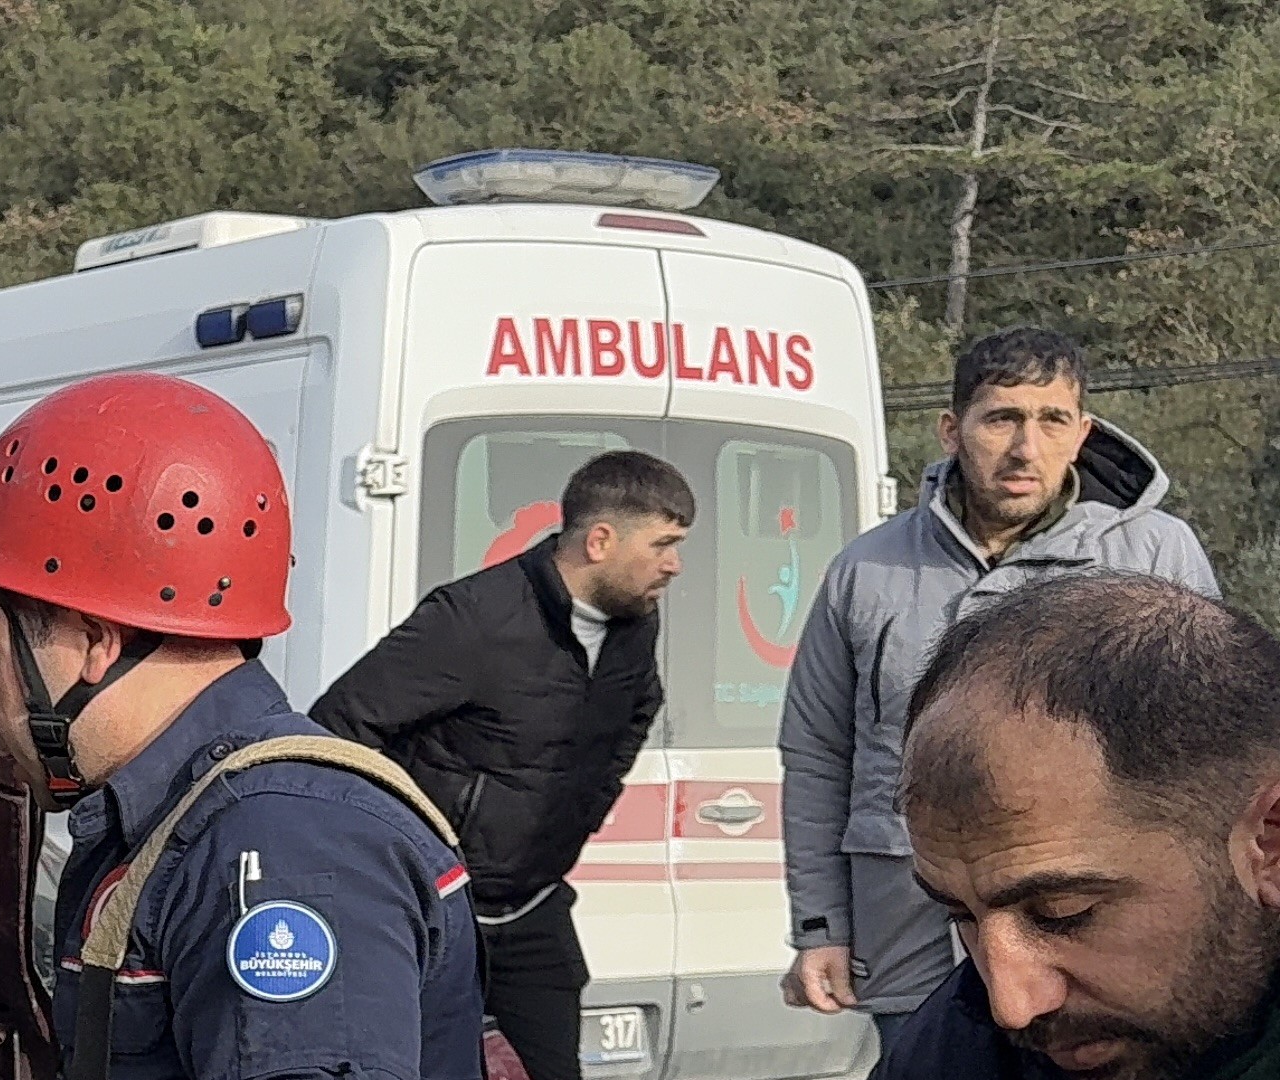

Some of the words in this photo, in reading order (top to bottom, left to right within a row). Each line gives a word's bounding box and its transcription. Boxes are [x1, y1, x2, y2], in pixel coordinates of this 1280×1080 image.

[485, 316, 814, 391] AMBULANS
[240, 957, 323, 973] BÜYÜKŞEHİR
[255, 951, 307, 959] İSTANBUL
[600, 1013, 636, 1051] 317
